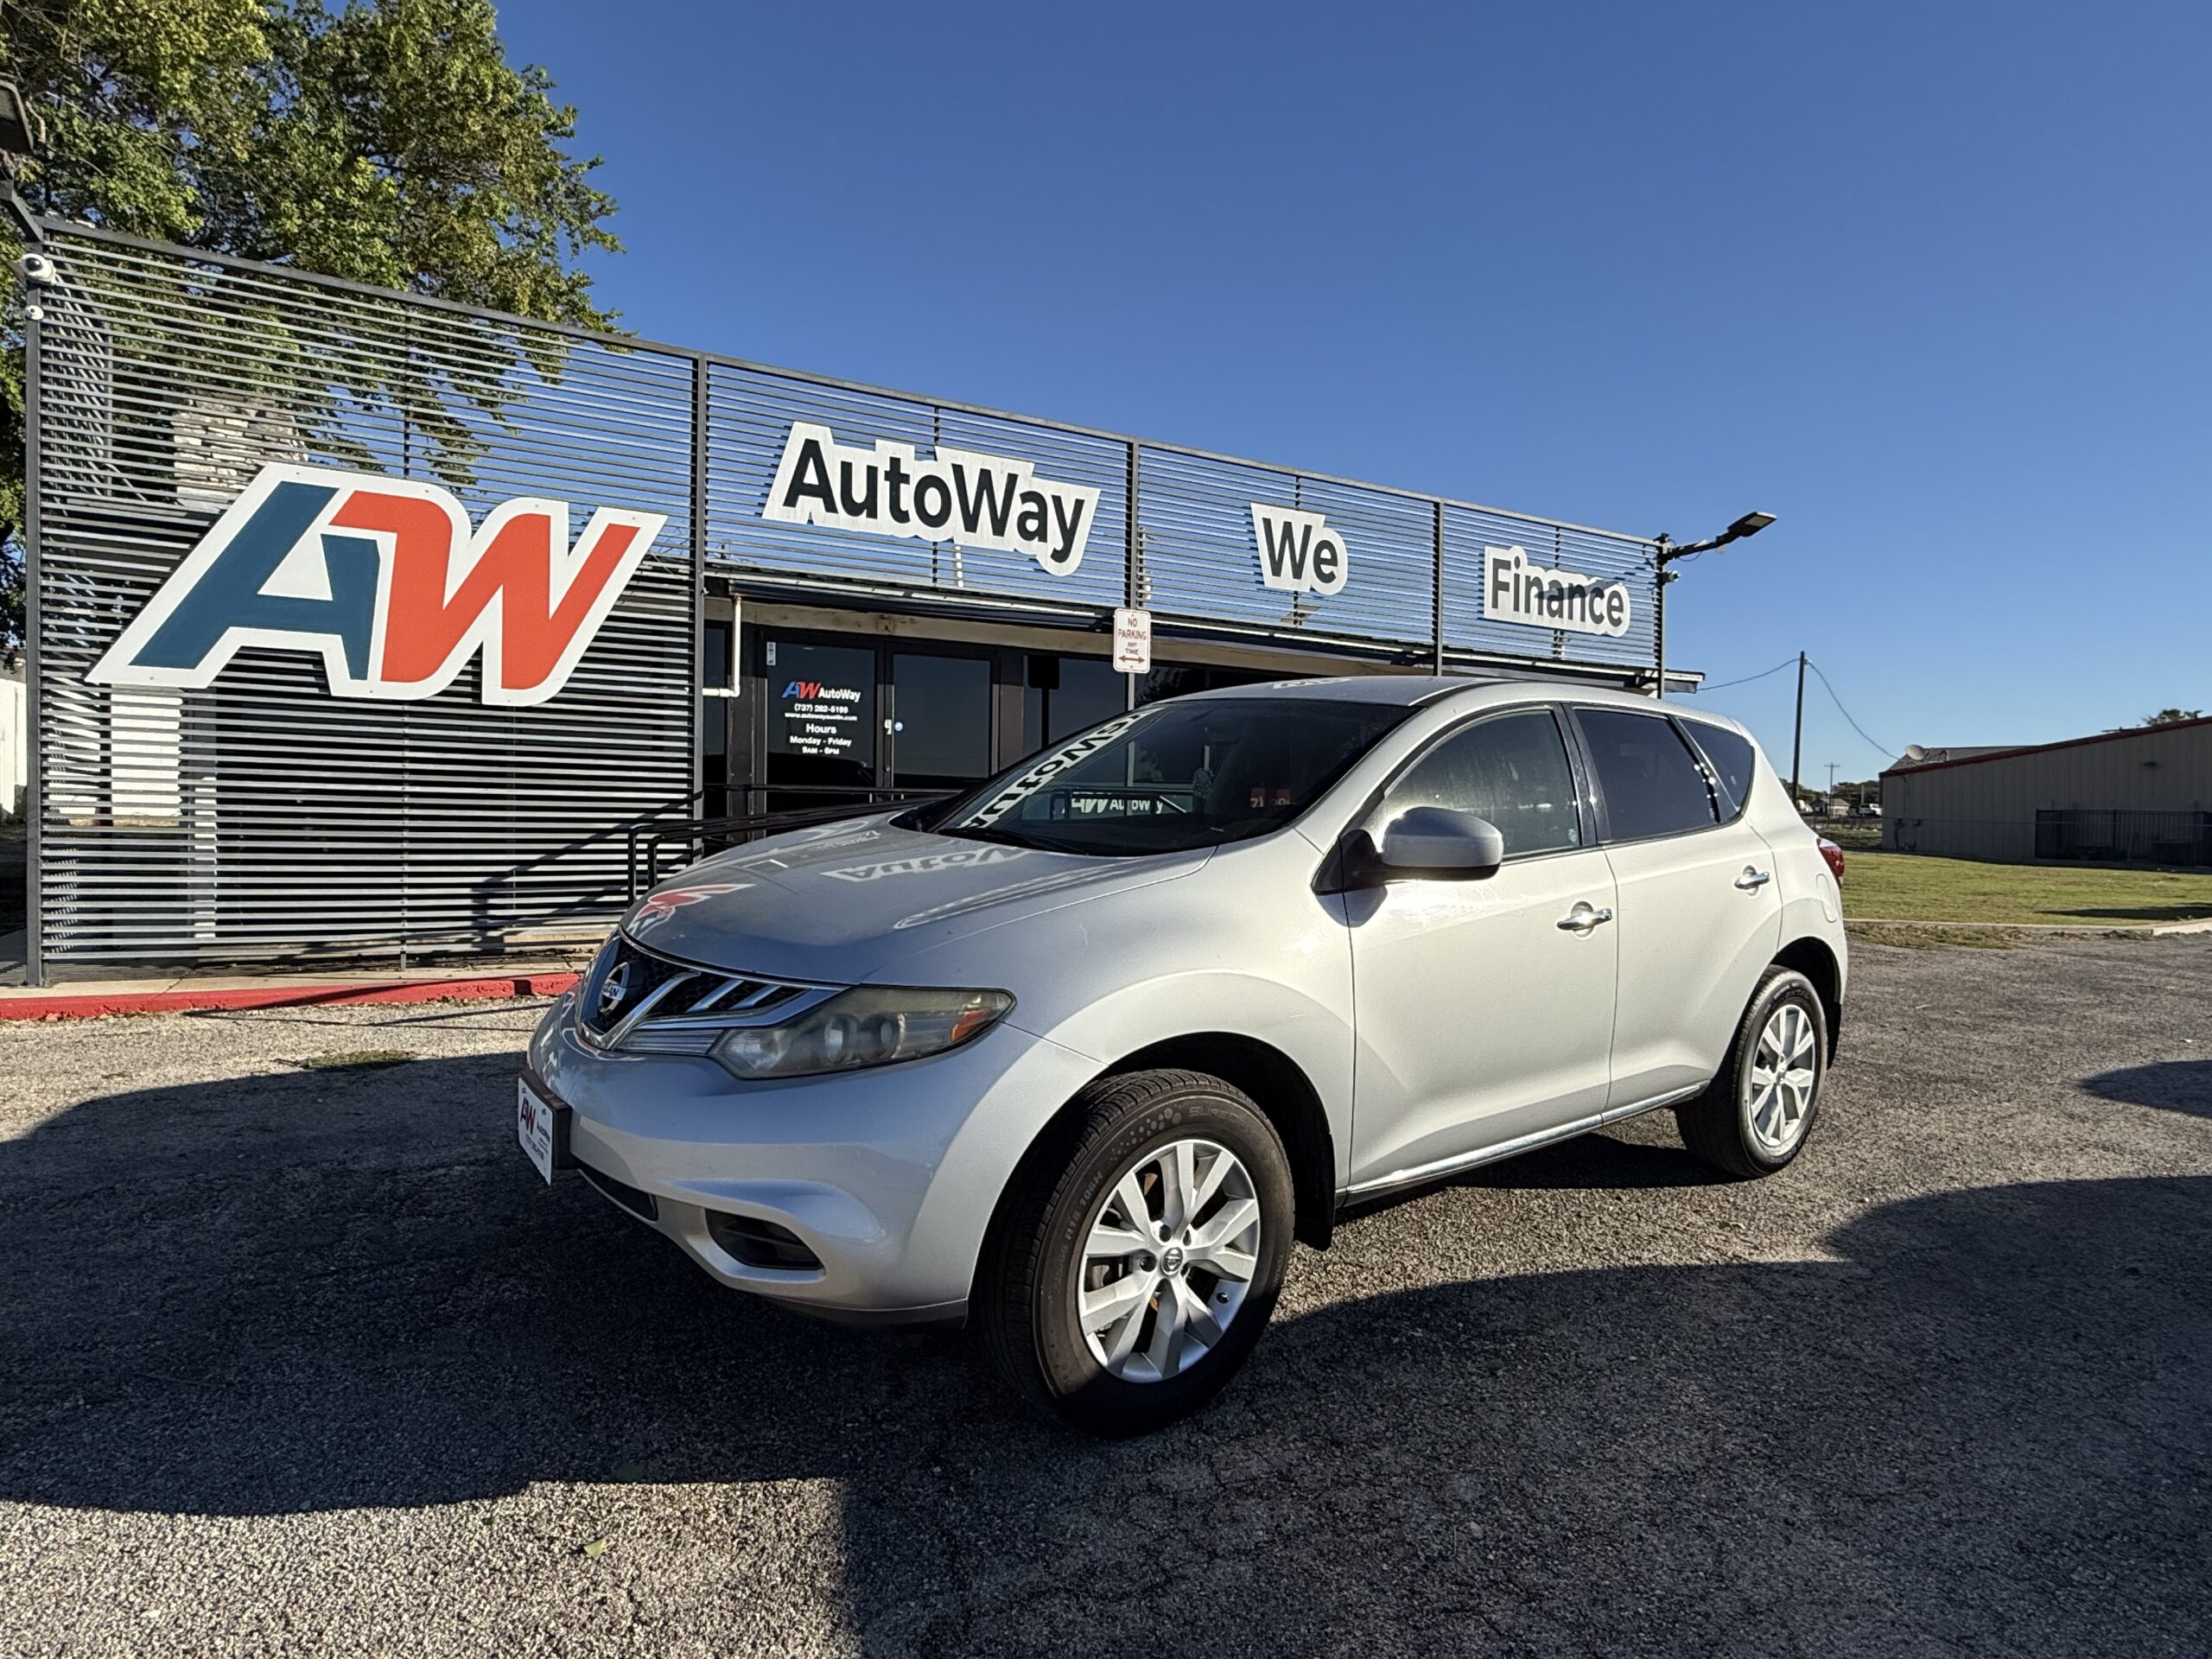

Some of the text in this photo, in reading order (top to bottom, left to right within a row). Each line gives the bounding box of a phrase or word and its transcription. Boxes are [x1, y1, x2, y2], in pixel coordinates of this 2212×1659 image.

[782, 437, 1624, 628] AutoWay We Finance
[127, 480, 642, 690] AW
[1128, 618, 1138, 627] NO
[1117, 628, 1147, 640] PARKING
[781, 681, 861, 702] AW AutoWay
[794, 702, 813, 713] (737)
[806, 723, 837, 734] Hours
[790, 735, 821, 747] Monday
[828, 737, 852, 747] Friday
